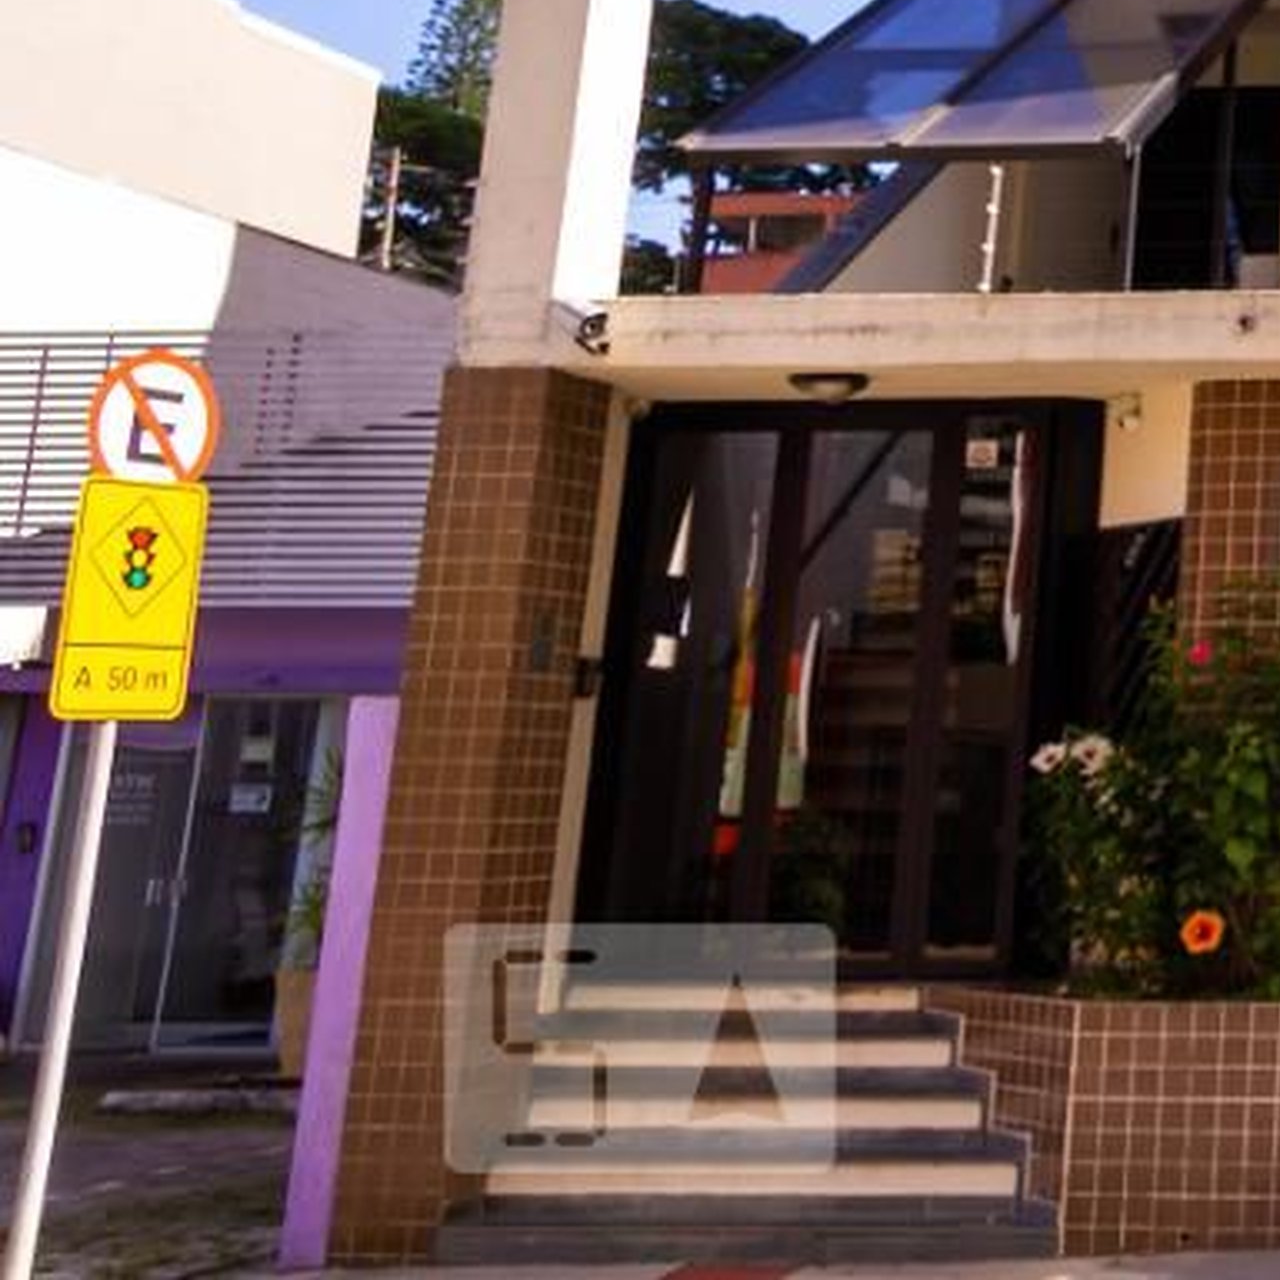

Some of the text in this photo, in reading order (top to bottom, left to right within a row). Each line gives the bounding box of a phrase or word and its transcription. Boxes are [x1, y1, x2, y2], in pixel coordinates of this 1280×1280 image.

[73, 666, 168, 692] A 50 m
